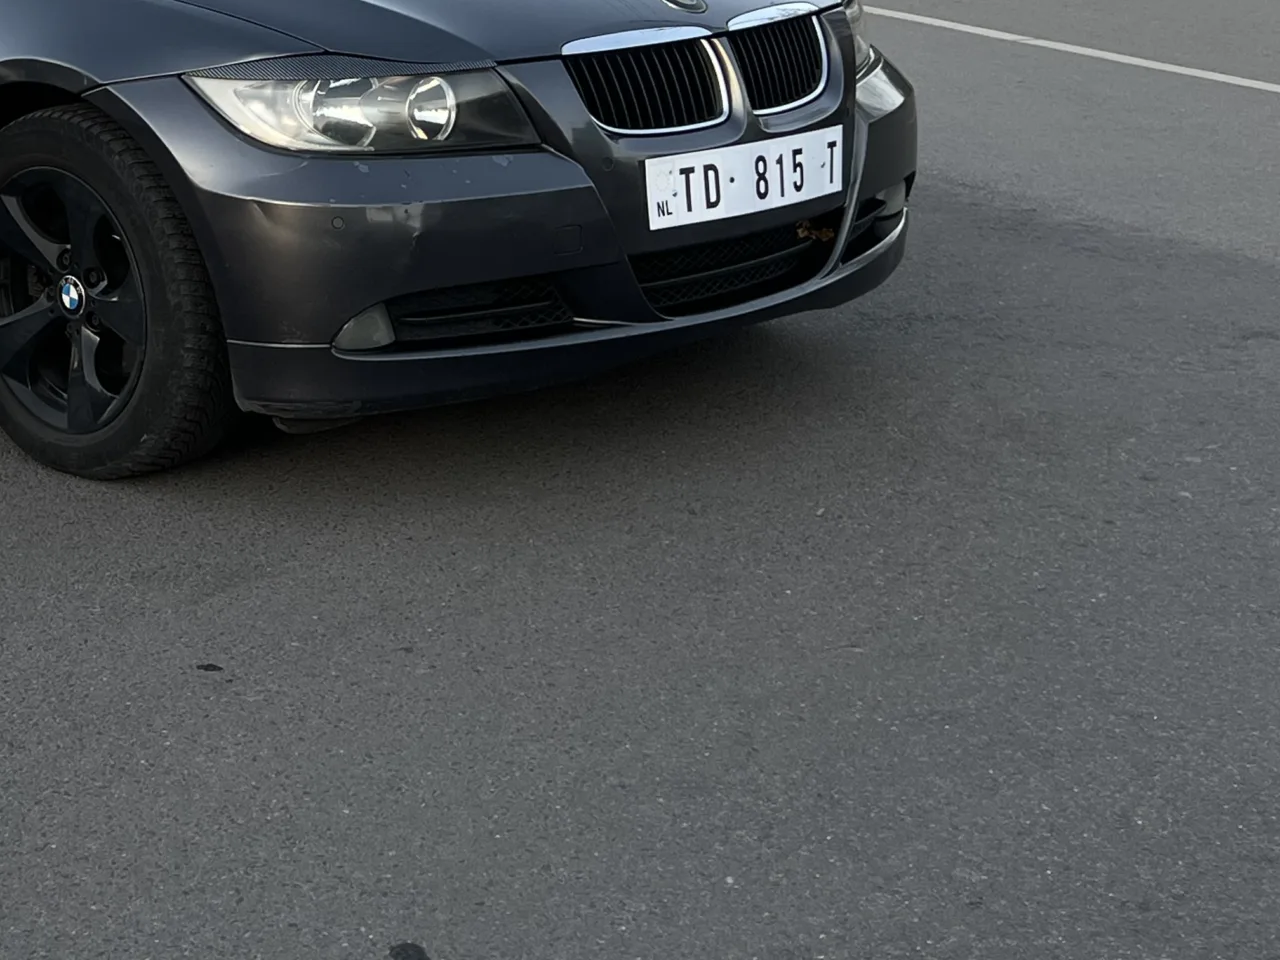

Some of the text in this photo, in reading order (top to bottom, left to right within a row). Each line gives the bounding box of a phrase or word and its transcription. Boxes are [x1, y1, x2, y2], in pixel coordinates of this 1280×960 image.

[679, 140, 838, 213] TD 815 T
[656, 199, 673, 218] NL
